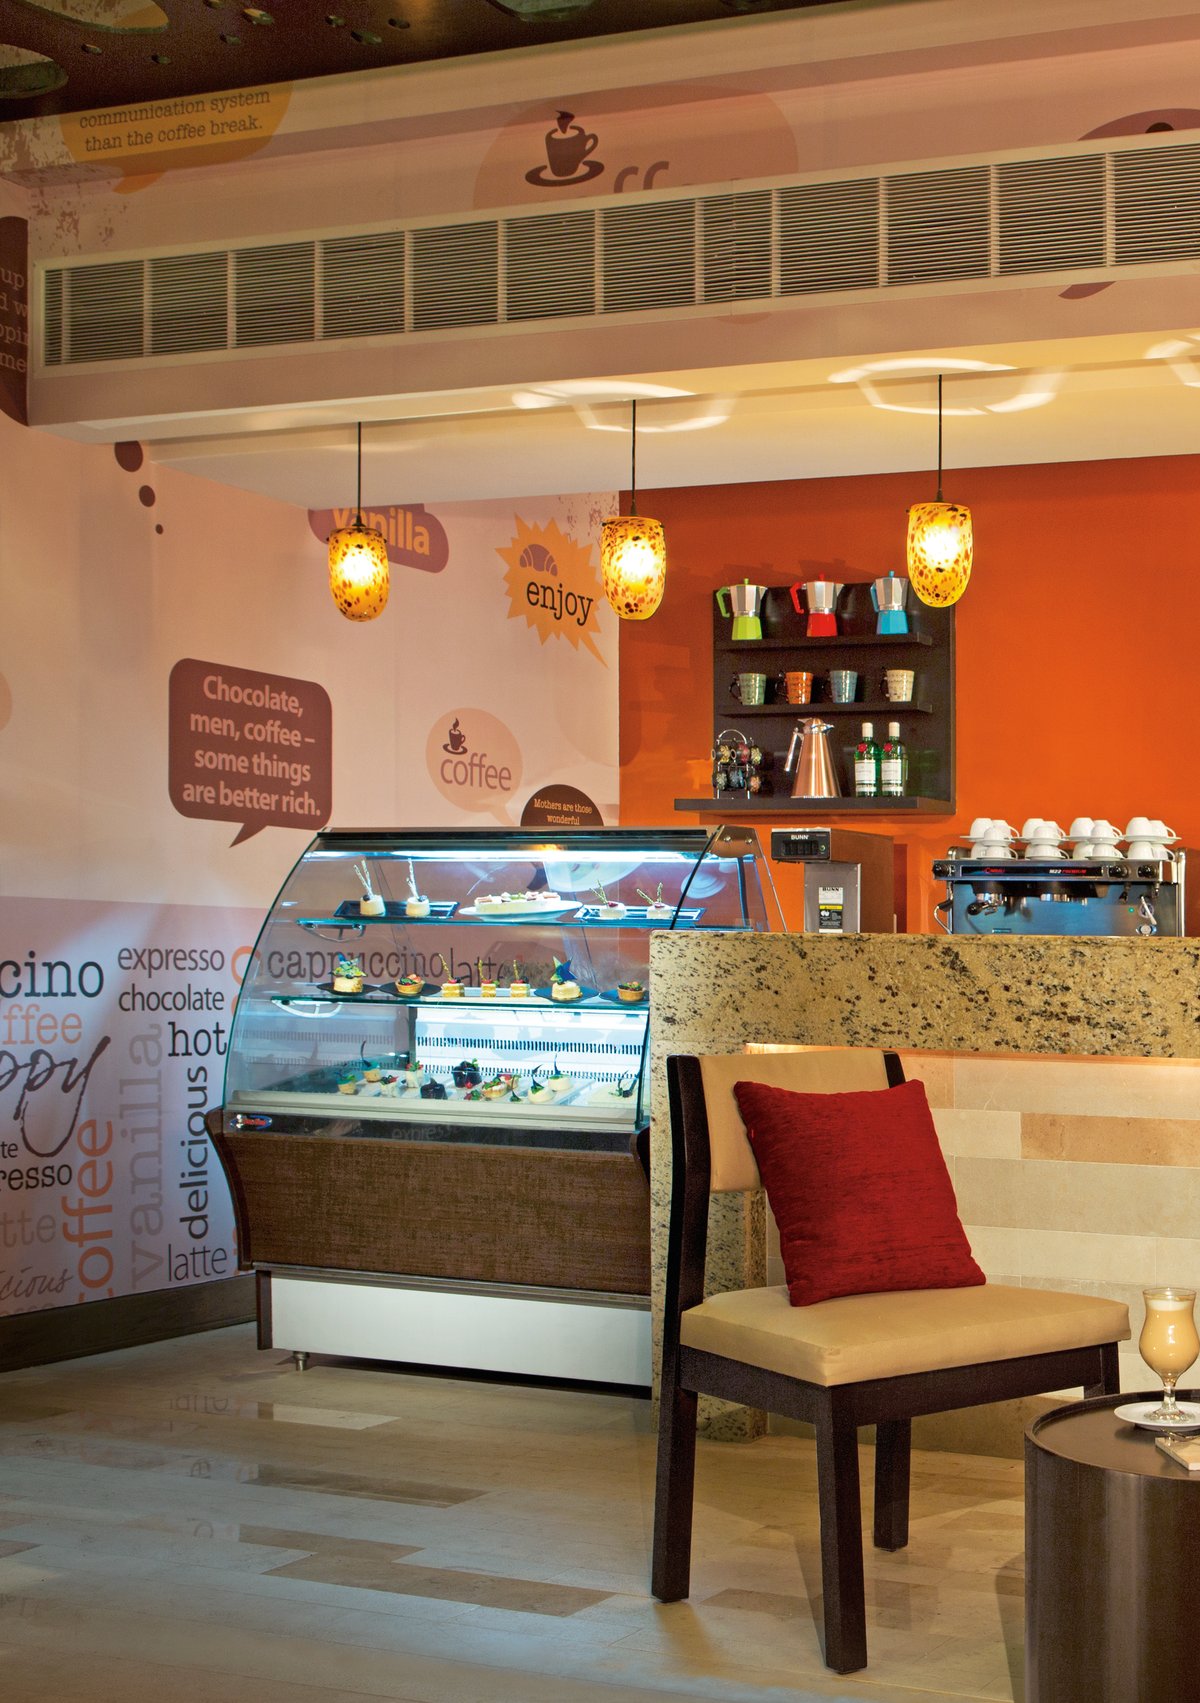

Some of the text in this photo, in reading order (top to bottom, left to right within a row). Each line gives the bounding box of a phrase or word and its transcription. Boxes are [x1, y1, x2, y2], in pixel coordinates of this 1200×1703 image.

[80, 90, 270, 129] communication system
[85, 115, 263, 152] than the coffee break.
[526, 581, 593, 626] enjoy
[203, 675, 303, 717] Chocolate,
[190, 713, 240, 741] men,
[244, 720, 301, 747] coffee
[194, 750, 311, 786] some things
[440, 752, 512, 791] coffee
[183, 781, 321, 816] are better rich.
[534, 798, 593, 814] Mothers are those
[547, 815, 580, 826] wonderful
[0, 950, 104, 998] cino
[117, 947, 225, 979] expresso
[118, 983, 225, 1012] chocolate
[2, 1003, 82, 1046] ffee
[167, 1021, 228, 1058] hot
[118, 1022, 164, 1290] vanilla
[179, 1066, 209, 1240] delicious
[168, 1243, 228, 1282] latte
